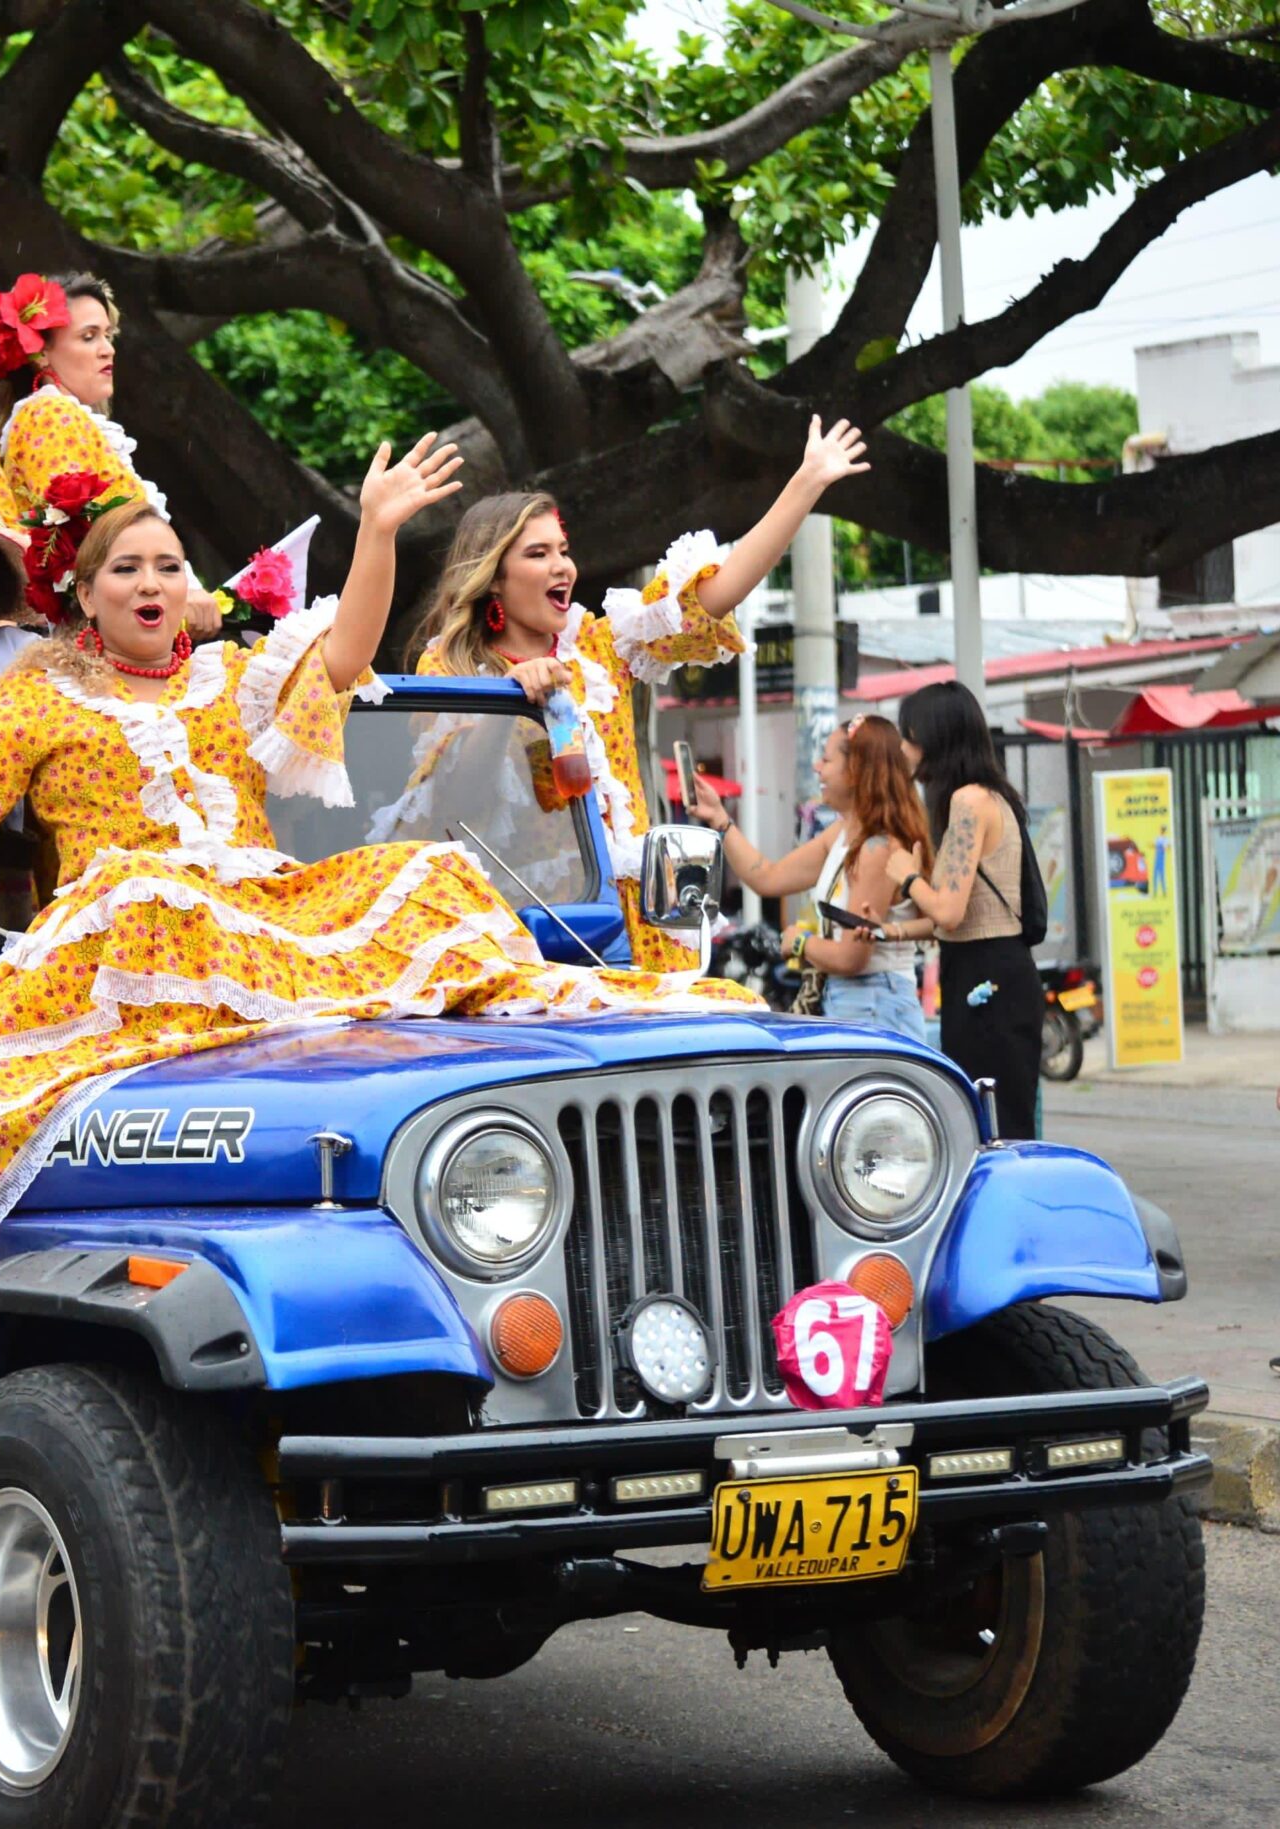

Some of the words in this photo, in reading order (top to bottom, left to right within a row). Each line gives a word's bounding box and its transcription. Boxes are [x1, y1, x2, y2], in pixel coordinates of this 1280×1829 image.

[1117, 807, 1168, 818] LAVADO
[1125, 795, 1159, 805] AUTO
[44, 1107, 255, 1166] ANGLER
[794, 1295, 878, 1397] 67
[721, 1500, 805, 1561] UWA
[826, 1489, 908, 1553] 715
[755, 1556, 860, 1578] VALLEDUPAR
